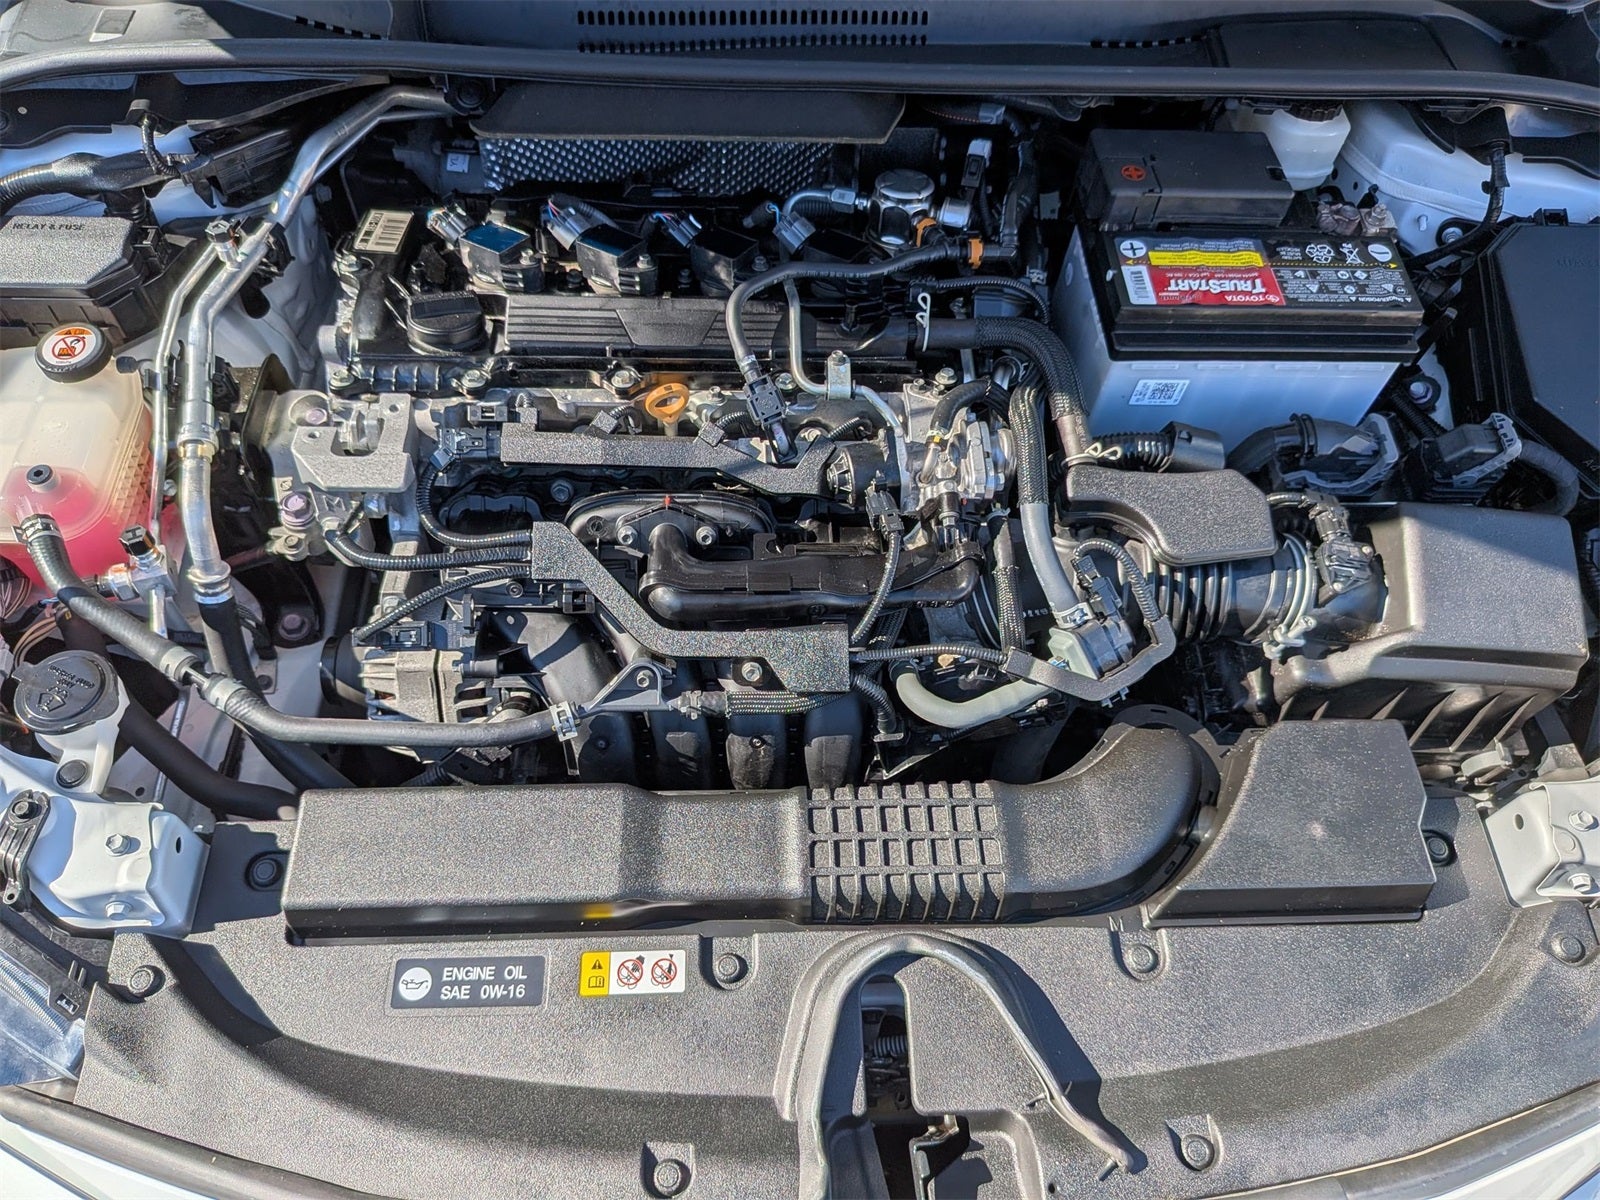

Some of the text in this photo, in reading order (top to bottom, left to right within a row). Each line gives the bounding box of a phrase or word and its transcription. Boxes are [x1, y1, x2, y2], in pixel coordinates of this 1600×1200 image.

[1224, 295, 1266, 303] TOYOTA
[442, 965, 528, 981] ENGINE OIL
[440, 984, 526, 1000] SAE 0W-16
